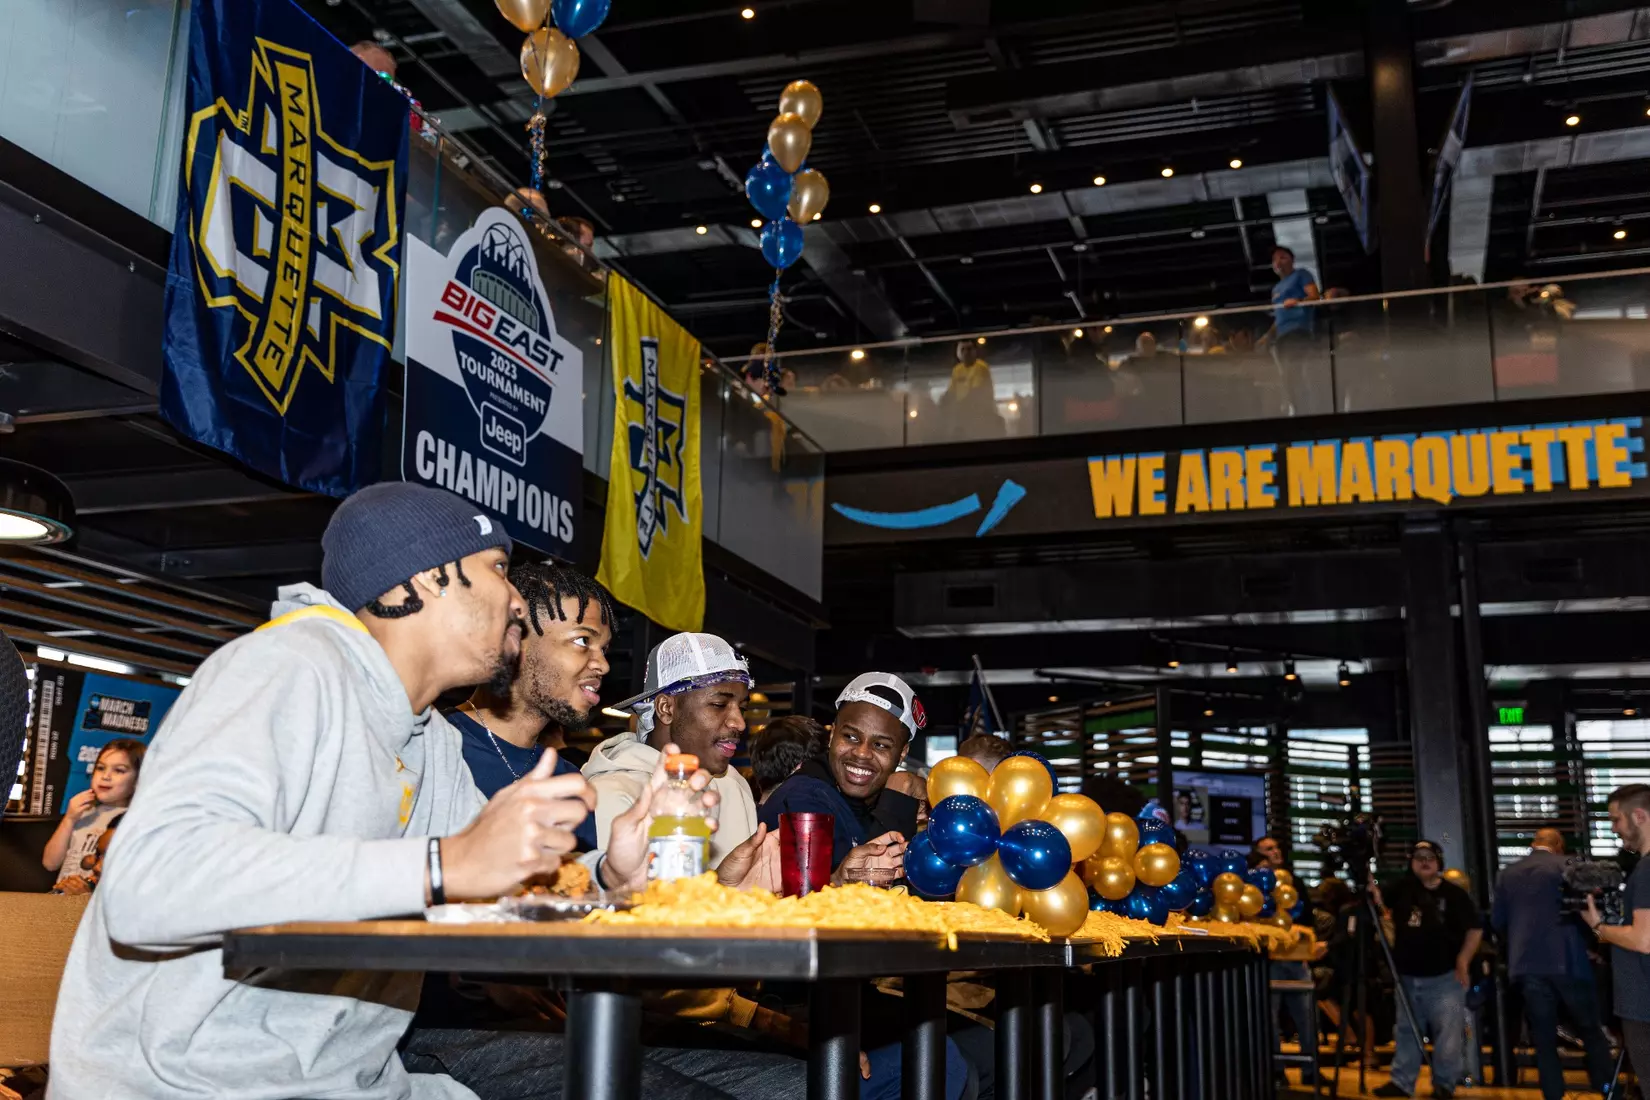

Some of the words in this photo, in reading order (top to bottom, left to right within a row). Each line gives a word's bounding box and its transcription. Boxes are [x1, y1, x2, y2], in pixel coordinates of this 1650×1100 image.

[263, 81, 306, 371] MARQUETTE
[441, 280, 497, 331] BIG
[494, 316, 564, 372] EAST
[490, 351, 518, 380] 2023
[459, 351, 547, 415] TOURNAMENT
[485, 415, 522, 454] Jeep
[1087, 452, 1167, 518] WE
[1175, 443, 1279, 514] ARE
[1286, 416, 1648, 507] MARQUETTE
[415, 430, 574, 543] CHAMPIONS
